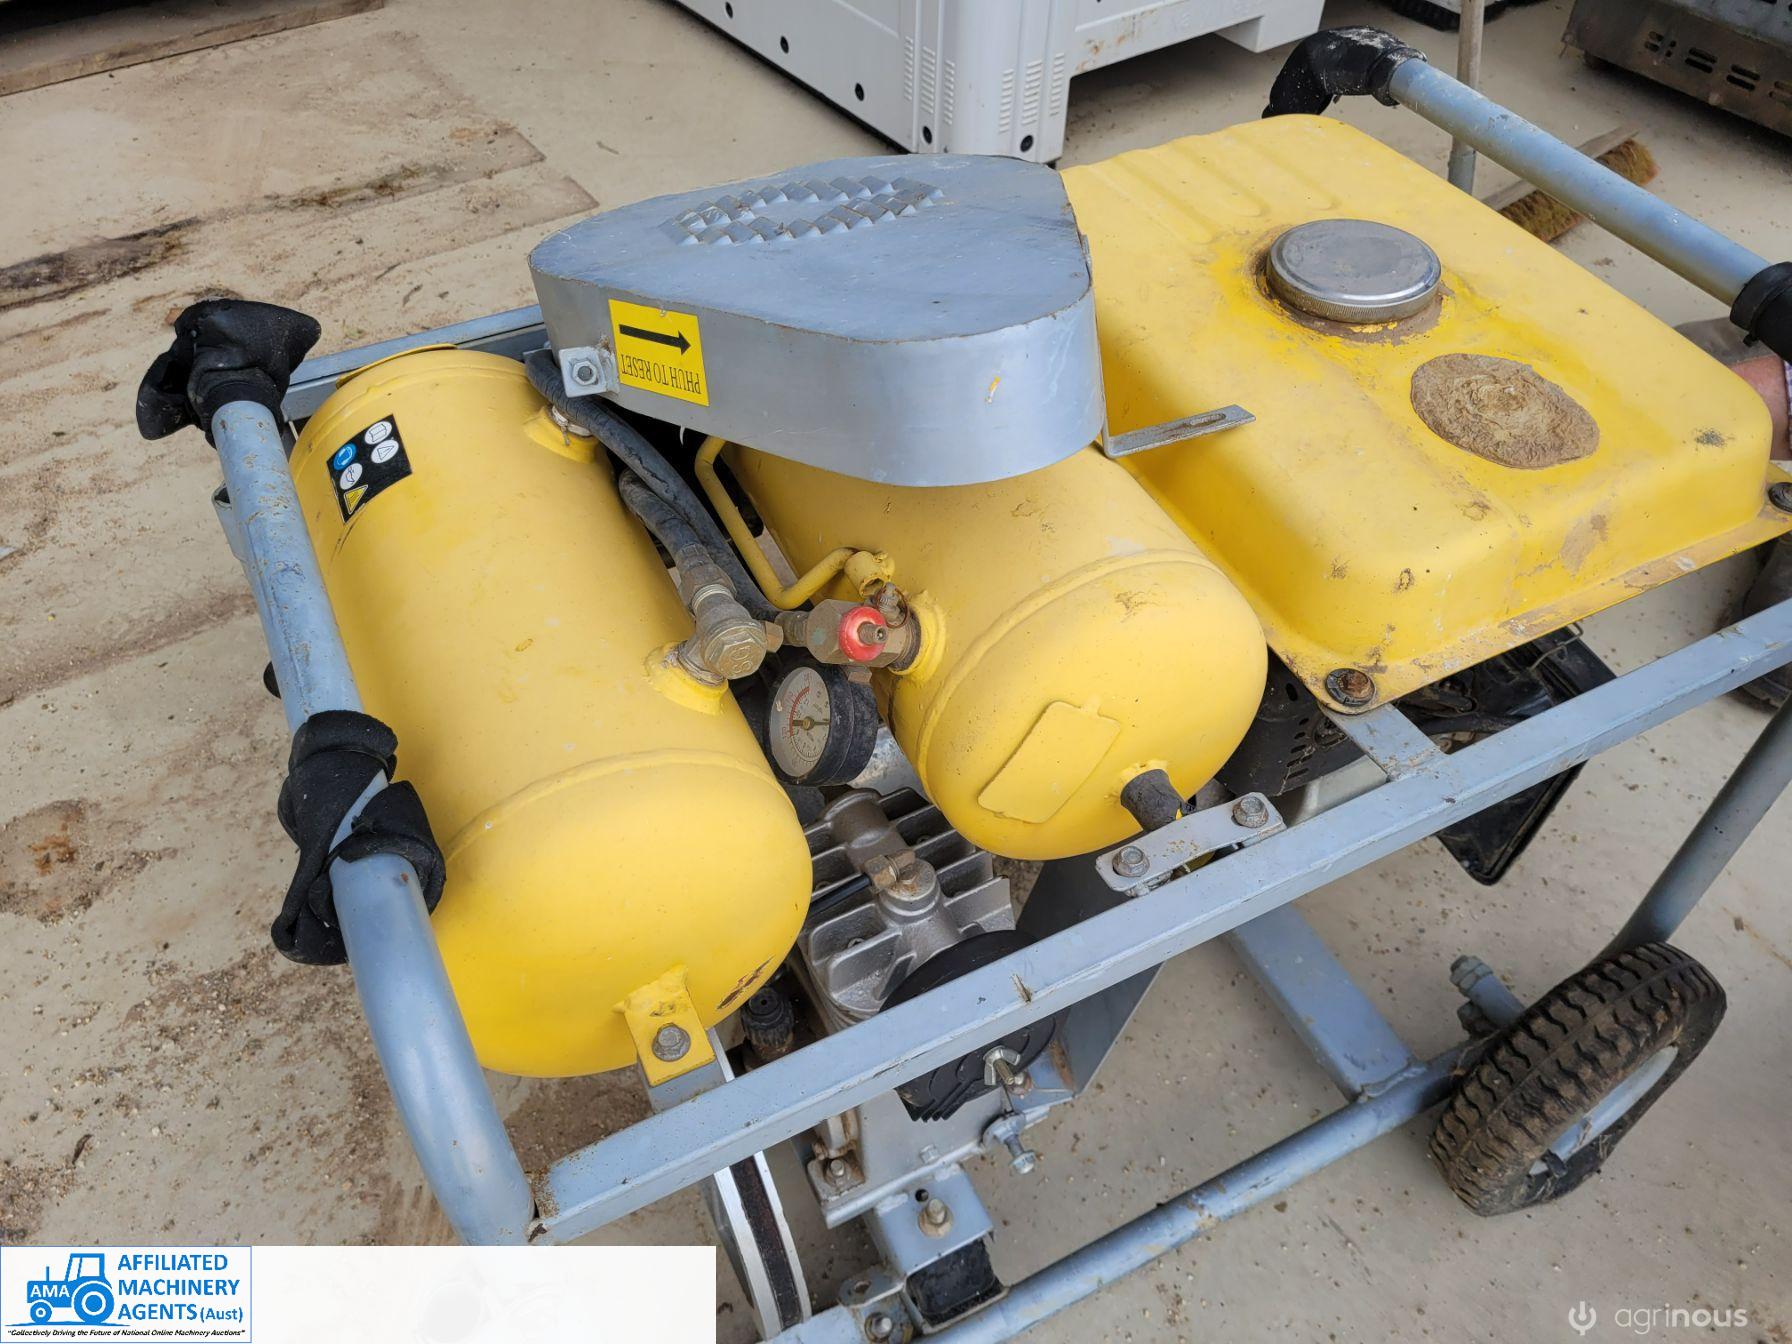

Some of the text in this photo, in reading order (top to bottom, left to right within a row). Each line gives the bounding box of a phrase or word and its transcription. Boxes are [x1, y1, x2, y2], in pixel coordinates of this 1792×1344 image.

[621, 353, 702, 394] PHUH TO RESET
